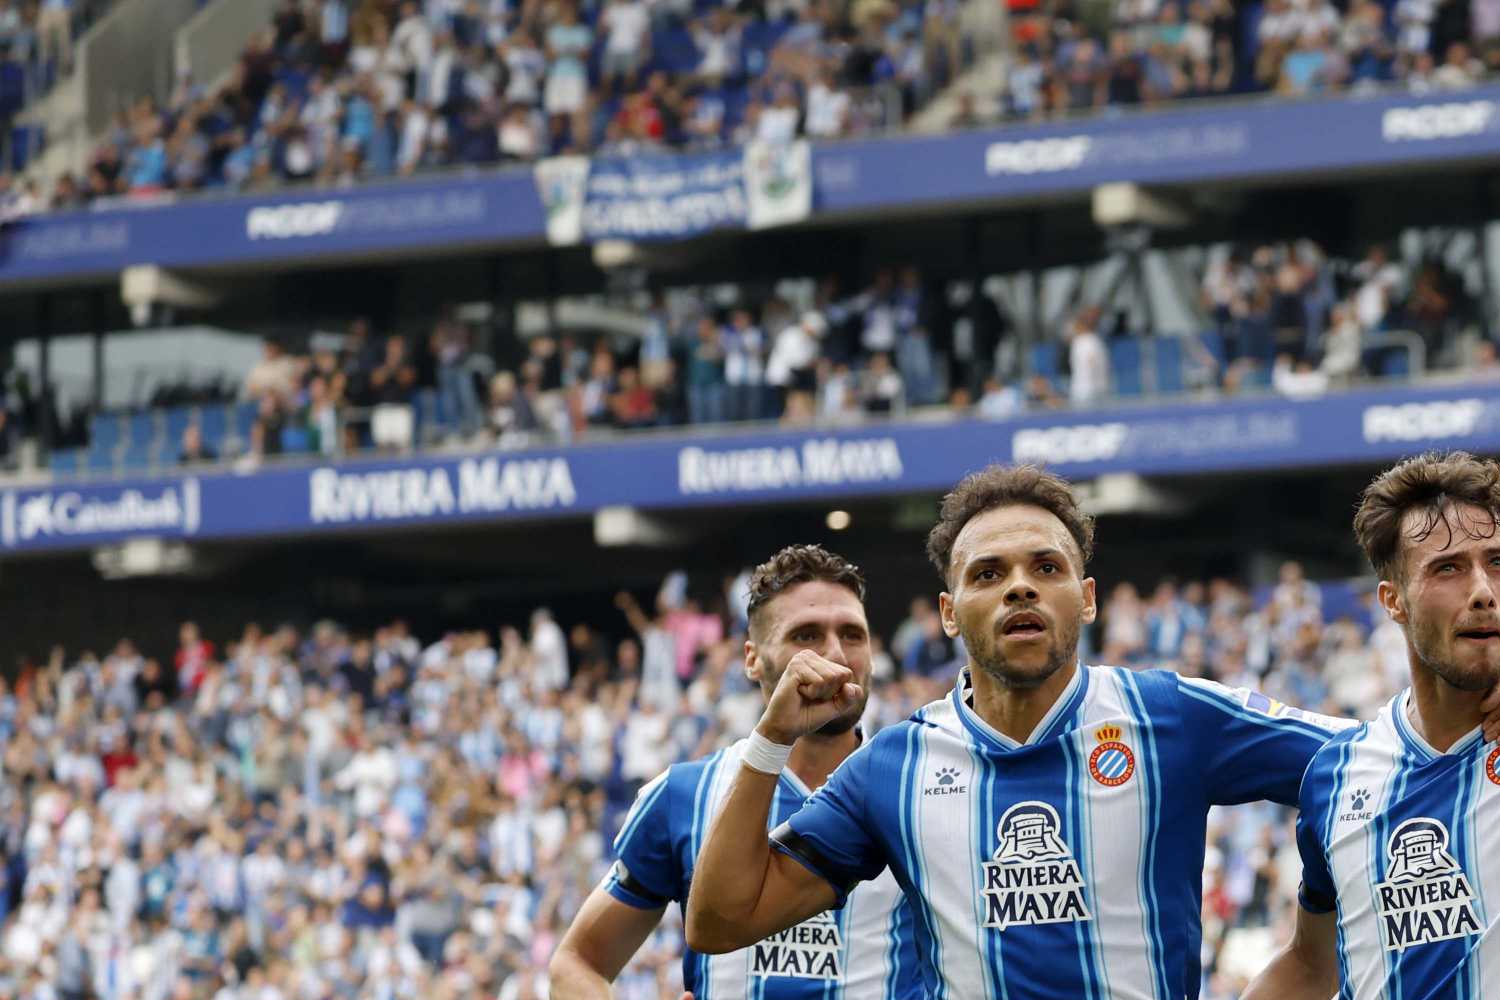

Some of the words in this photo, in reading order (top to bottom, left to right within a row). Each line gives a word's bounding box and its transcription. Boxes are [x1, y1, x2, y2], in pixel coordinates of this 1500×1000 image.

[310, 467, 455, 524] RIVIERA
[924, 786, 967, 796] KELME
[1340, 812, 1373, 822] KELME
[987, 864, 1080, 889] RIVIERA
[988, 890, 1086, 923] MAYA
[1380, 877, 1470, 912] RIVIERA
[1384, 904, 1480, 946] MAYA
[753, 944, 838, 976] MAYA
